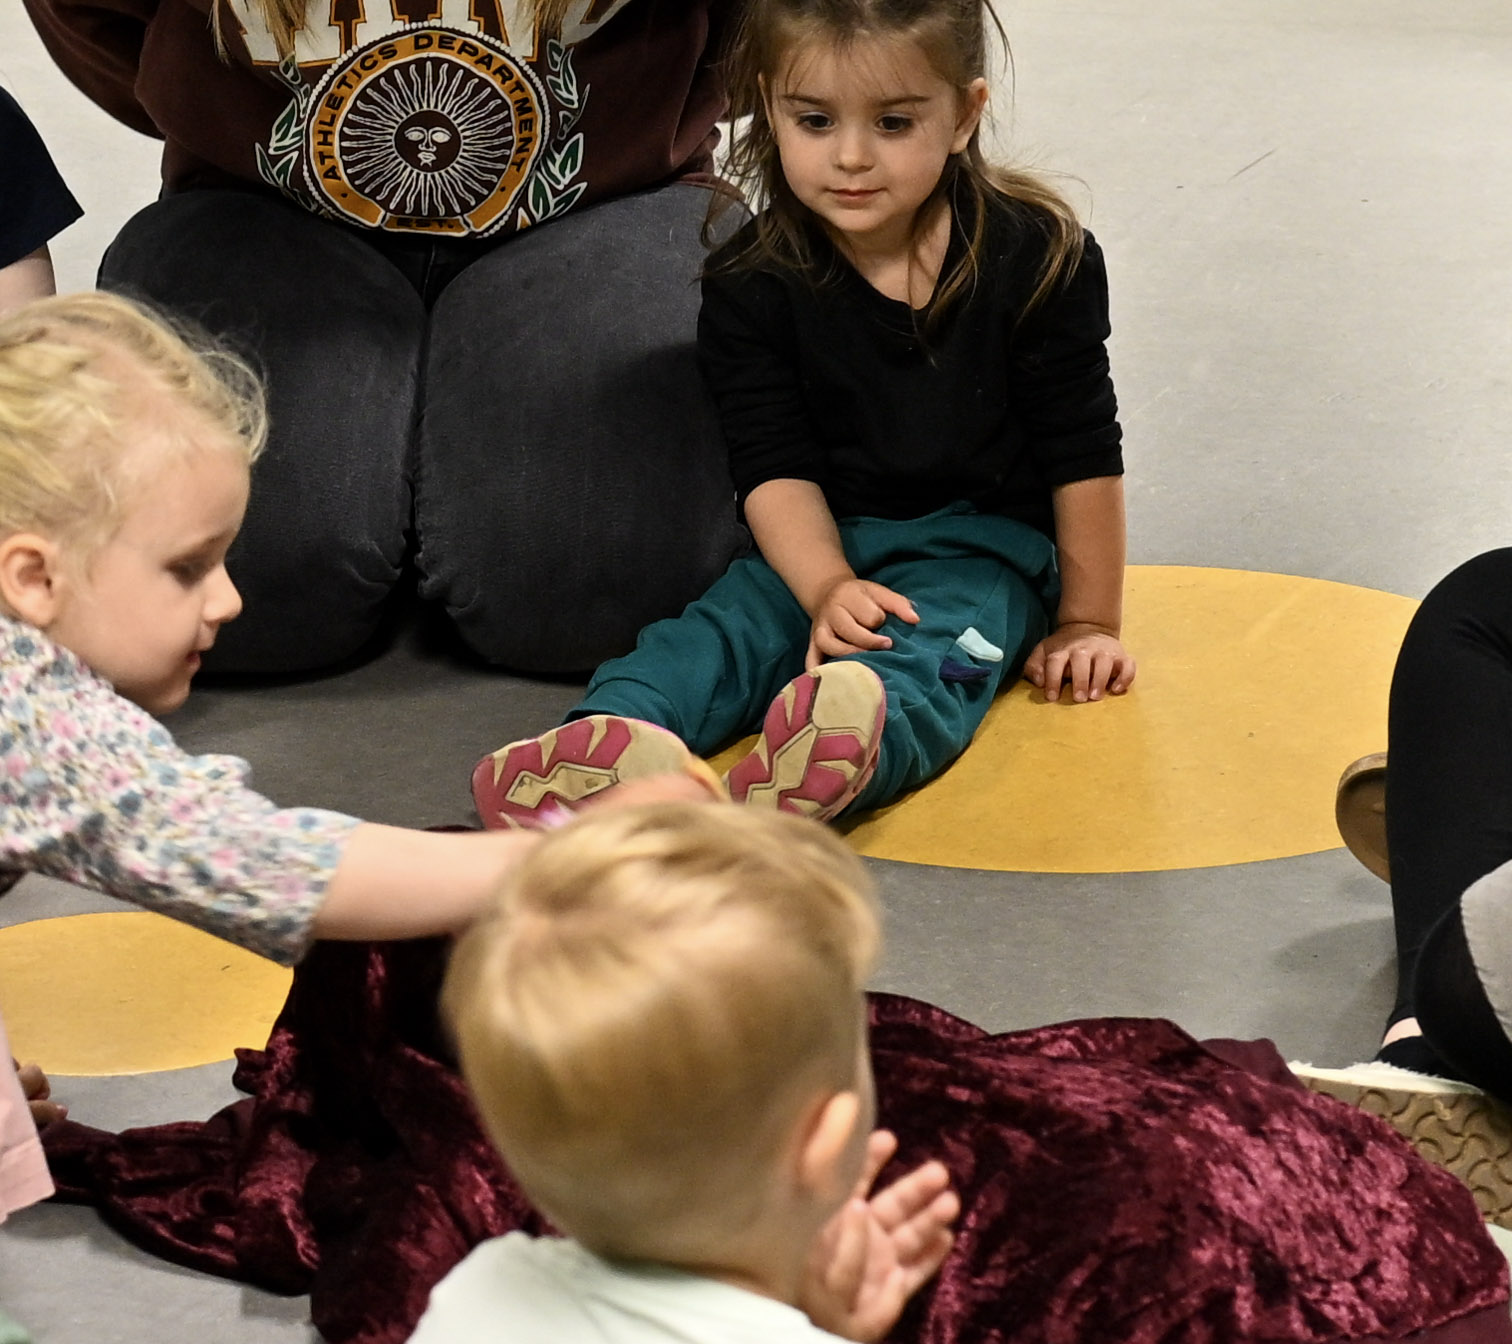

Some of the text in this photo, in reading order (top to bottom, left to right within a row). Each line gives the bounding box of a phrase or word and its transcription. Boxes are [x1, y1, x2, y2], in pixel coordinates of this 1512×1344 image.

[317, 34, 534, 181] ATHLETICS DEPARTMENT
[396, 217, 455, 229] EST.
